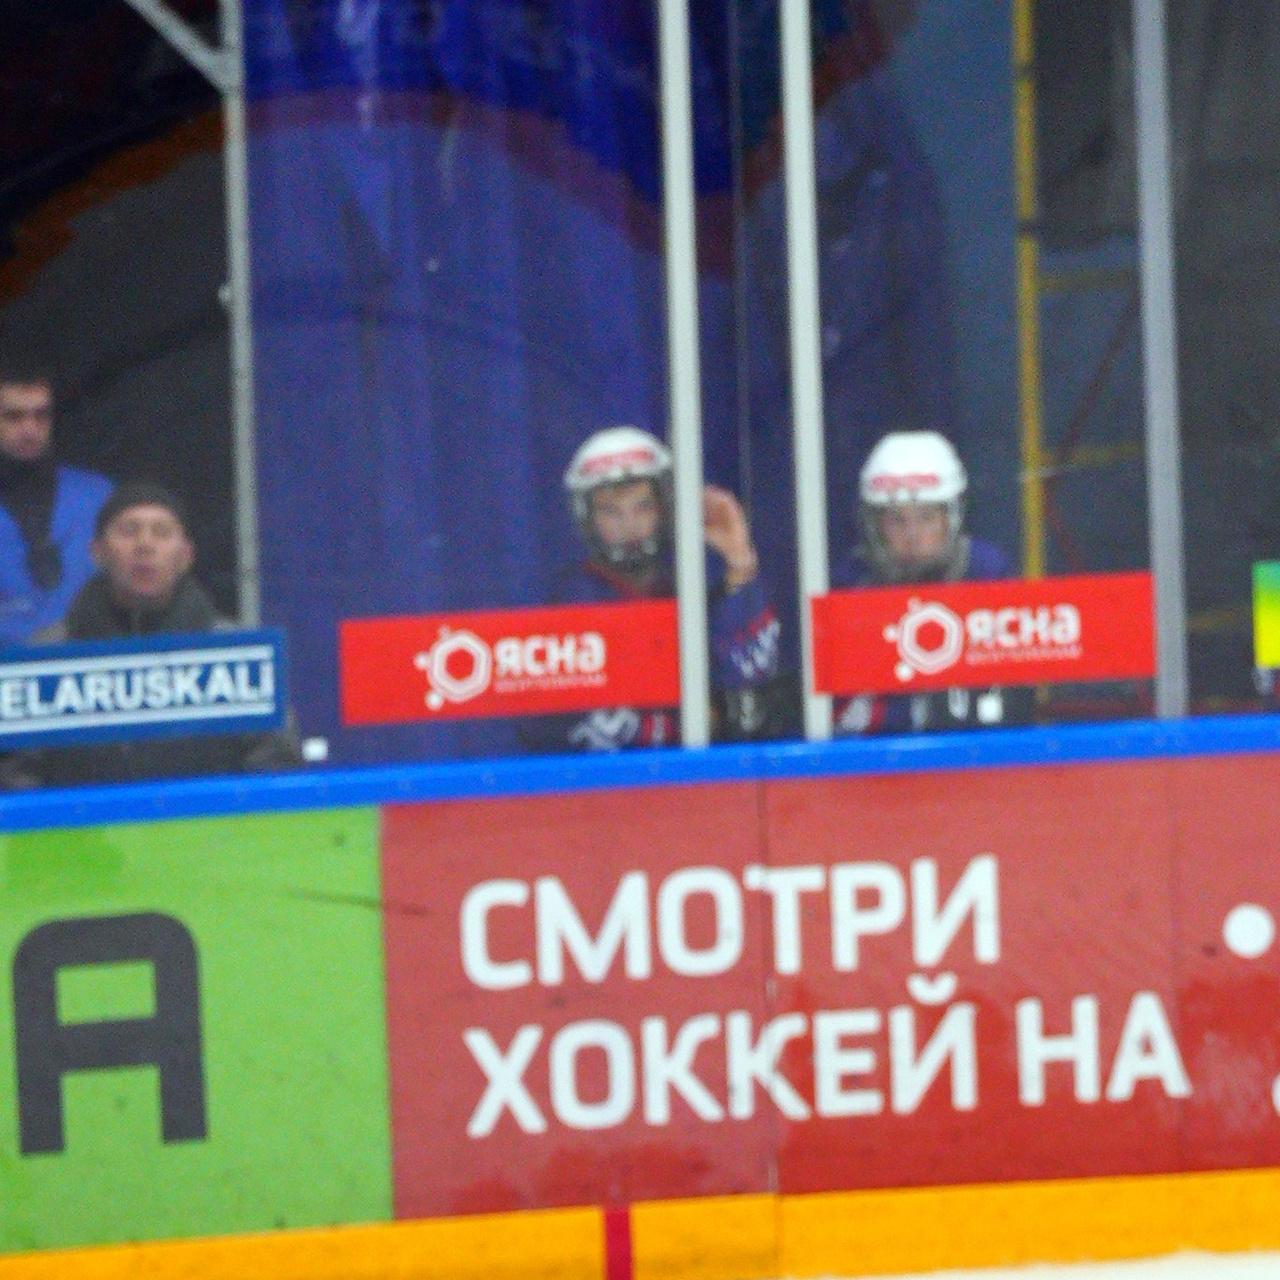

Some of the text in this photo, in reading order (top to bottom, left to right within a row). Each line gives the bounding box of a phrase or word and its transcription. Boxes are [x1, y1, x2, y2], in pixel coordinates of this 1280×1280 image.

[460, 855, 1000, 989] СМОТРИ
[462, 972, 1194, 1139] ХОККЕЙ НА
